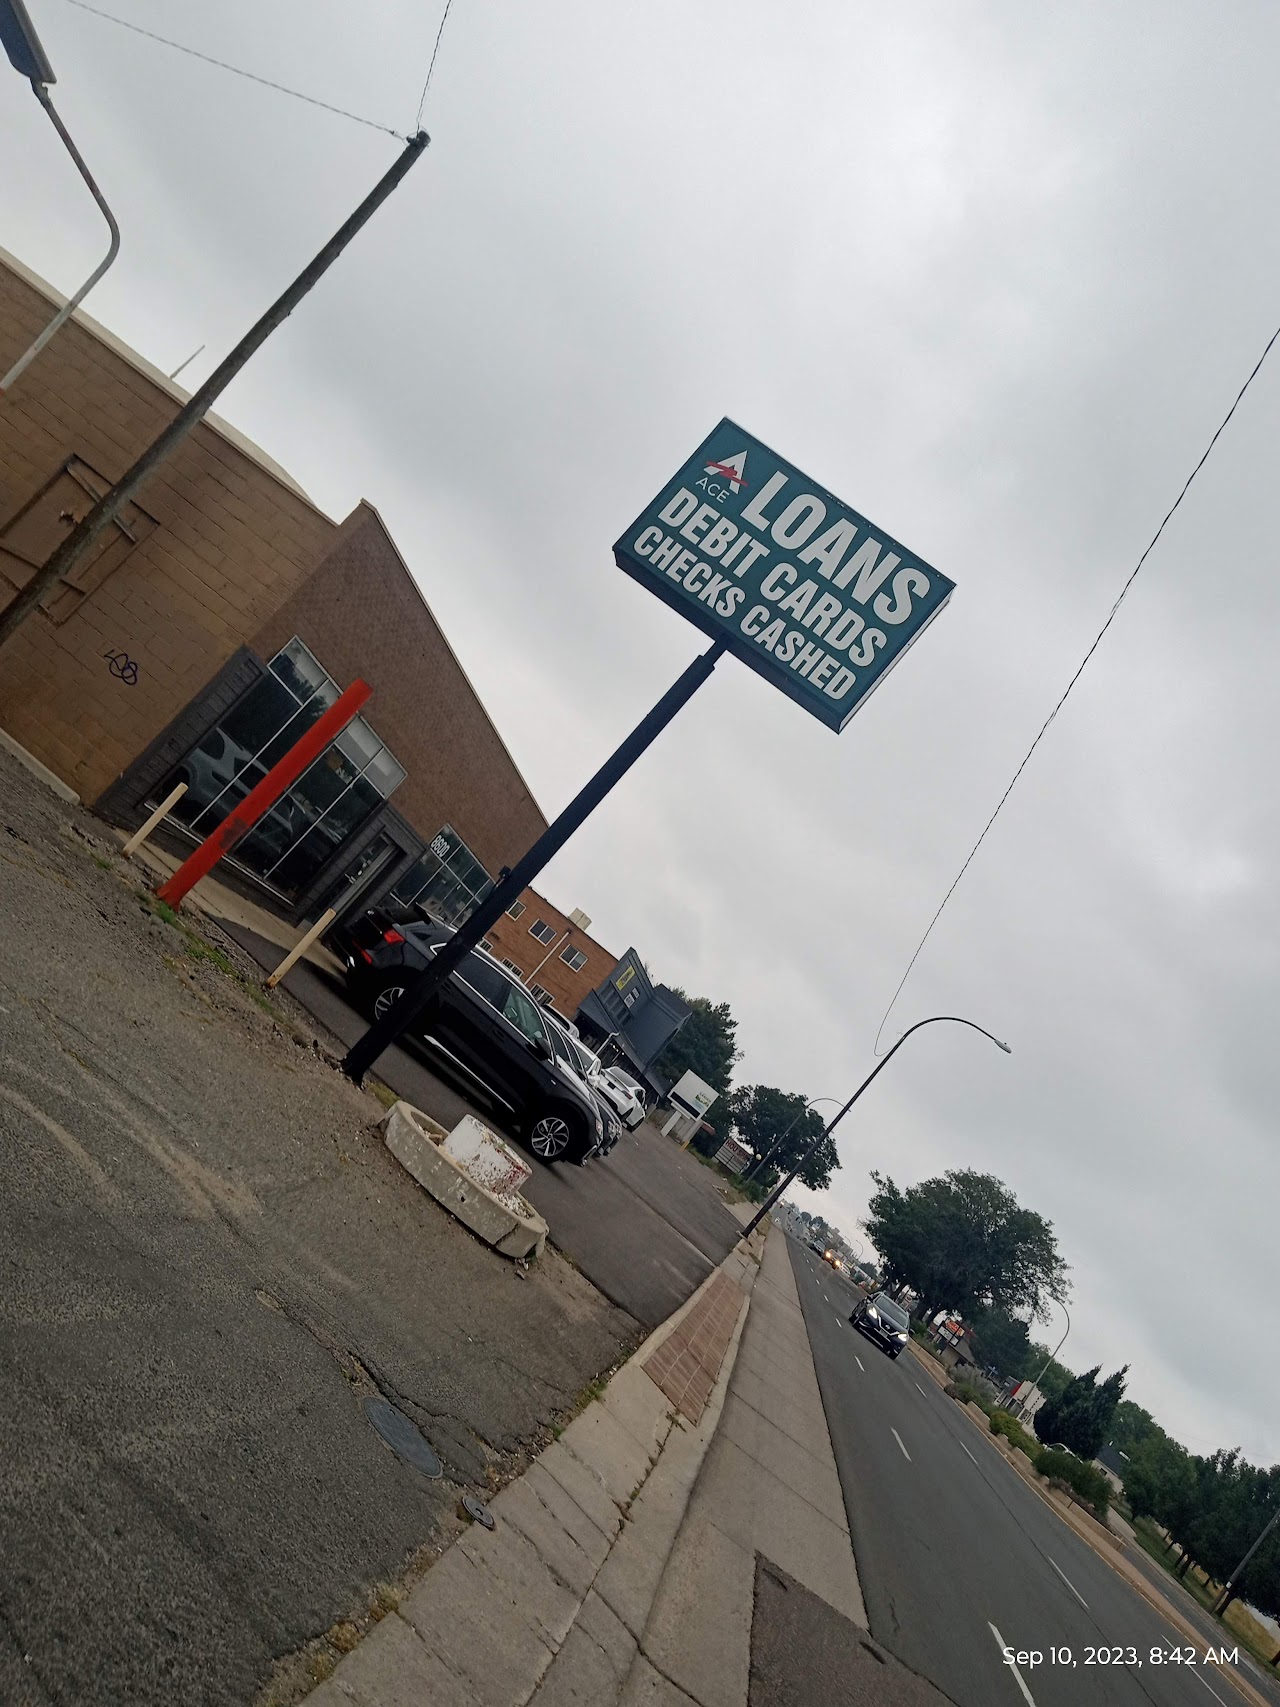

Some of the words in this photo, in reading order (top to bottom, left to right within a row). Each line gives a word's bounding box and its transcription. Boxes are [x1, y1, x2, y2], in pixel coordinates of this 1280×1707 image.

[695, 477, 730, 504] ACE
[740, 470, 931, 625] LOANS
[633, 525, 746, 618] CHECKS
[739, 604, 857, 700] CASHED
[657, 487, 771, 577] DEBIT
[759, 562, 887, 667] CARDS
[430, 835, 450, 858] 8600
